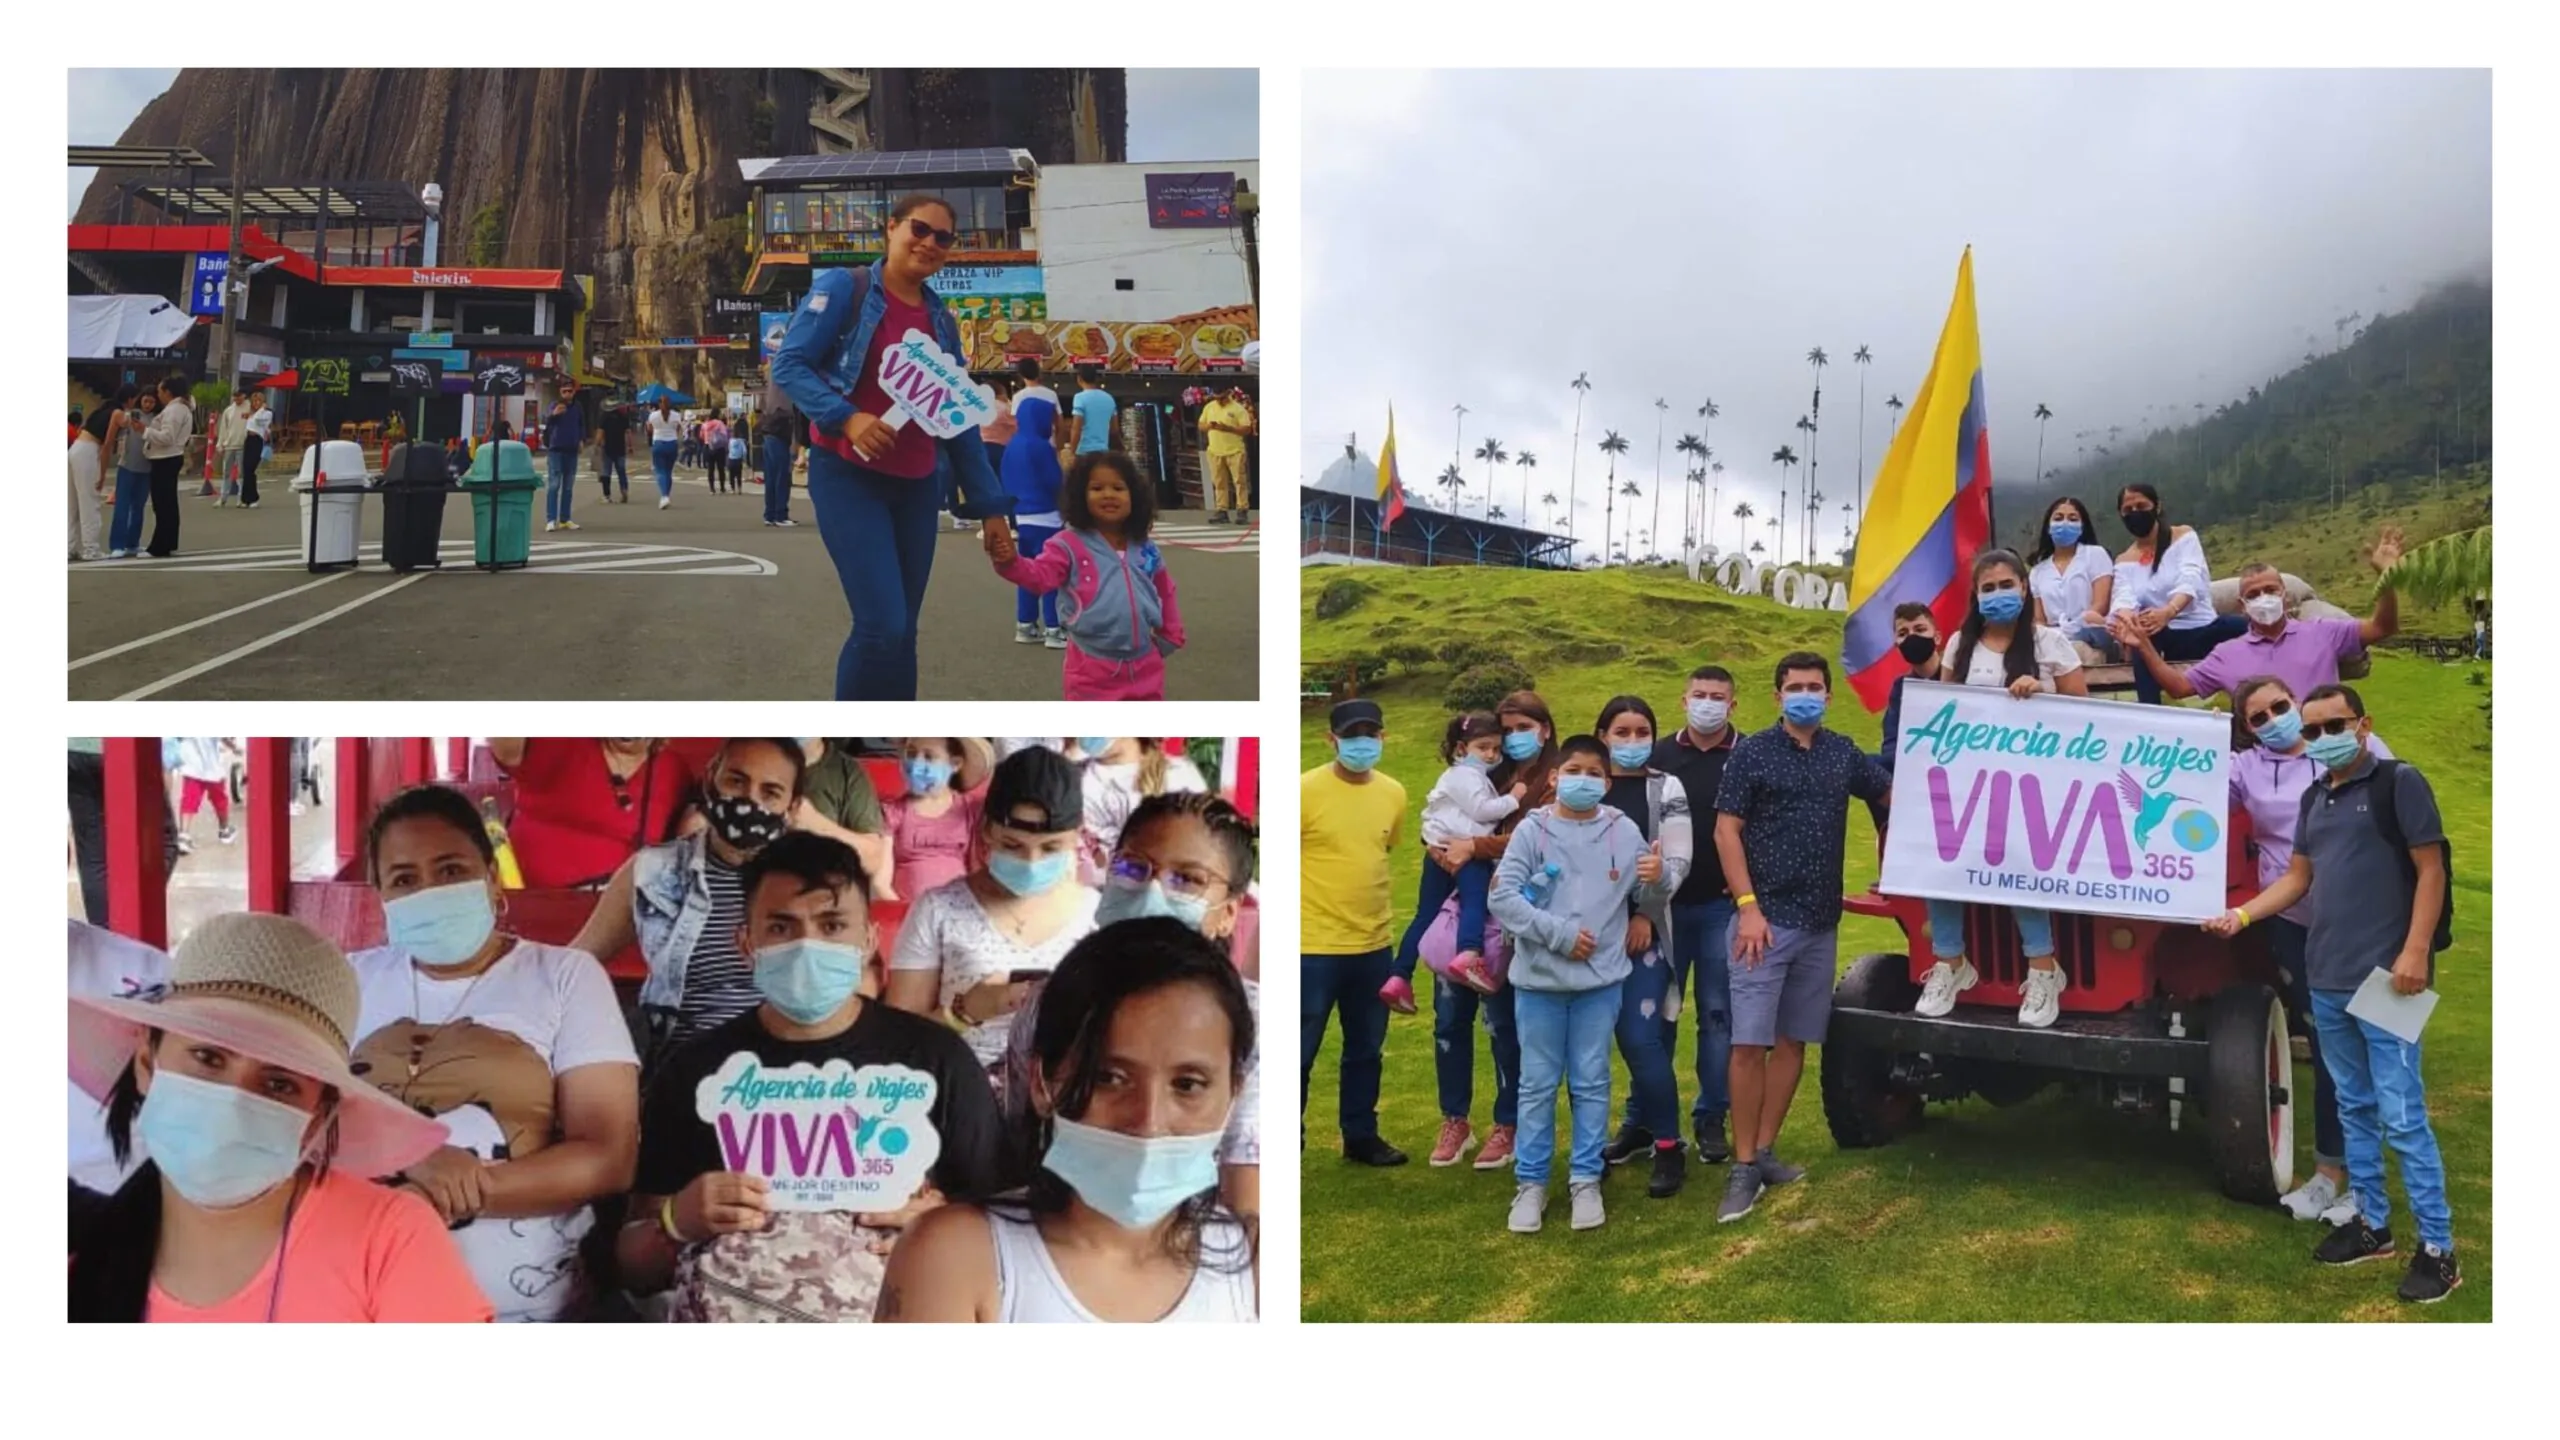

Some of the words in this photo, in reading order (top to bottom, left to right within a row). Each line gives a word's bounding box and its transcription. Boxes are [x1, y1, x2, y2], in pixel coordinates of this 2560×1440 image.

[934, 280, 972, 290] LETRAS
[984, 267, 1004, 278] VIP
[723, 299, 752, 311] Baños
[883, 350, 943, 418] VIVA
[945, 375, 960, 387] de
[1686, 544, 1849, 611] COCORA
[1903, 699, 2060, 765] Agencia
[2064, 722, 2108, 762] de
[2121, 735, 2217, 789] viajes
[1927, 766, 2133, 880] VIVA
[2142, 853, 2195, 881] 365
[1966, 869, 1992, 886] TU
[1998, 873, 2069, 895] MEJOR
[2075, 881, 2170, 904] DESTINO
[721, 1063, 825, 1110] Agencia
[829, 1072, 857, 1098] de
[865, 1077, 928, 1113] viajes
[717, 1111, 856, 1178] VIVA
[862, 1158, 894, 1175] 365
[772, 1179, 818, 1190] MEJOR
[821, 1180, 880, 1191] DESTINO
